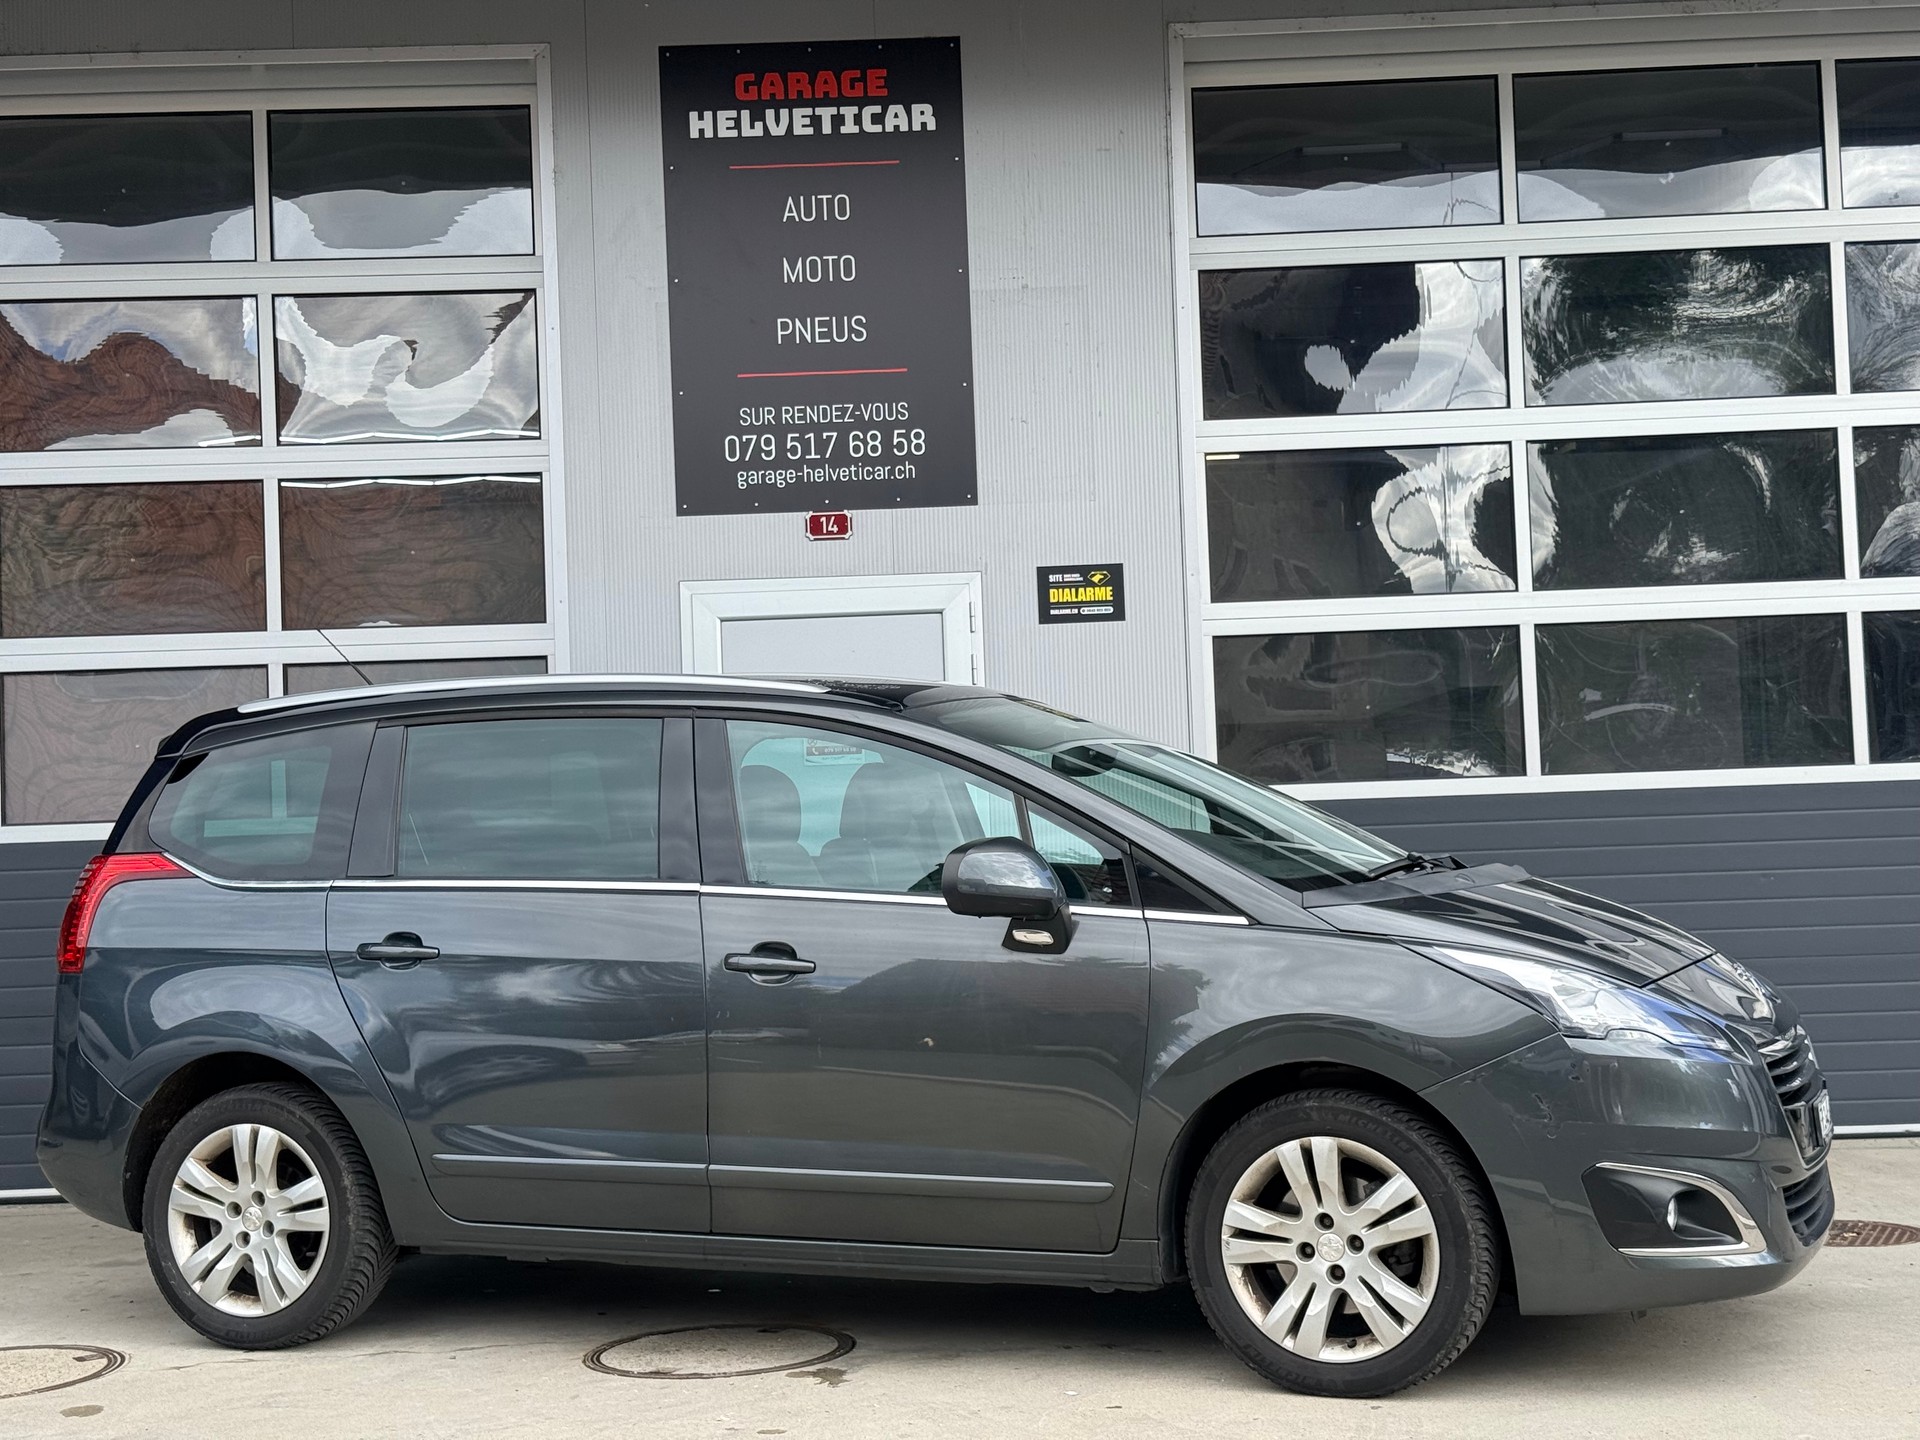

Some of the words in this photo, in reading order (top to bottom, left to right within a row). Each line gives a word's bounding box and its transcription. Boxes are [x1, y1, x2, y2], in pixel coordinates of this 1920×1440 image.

[735, 69, 888, 101] GARAGE
[690, 104, 936, 138] HELVETICAR
[783, 194, 849, 222] AUTO
[783, 255, 855, 283] MOTO
[777, 315, 866, 344] PNEUS
[740, 407, 775, 425] SUR
[782, 402, 908, 424] RENDEZ-VOUS
[725, 434, 775, 462] 079
[787, 432, 837, 459] 517
[849, 430, 881, 457] 68
[893, 429, 925, 455] 58
[737, 461, 916, 489] garage-helveticar.ch
[820, 515, 839, 534] 14
[1049, 574, 1062, 582] SITE
[1049, 586, 1113, 603] DIALARME
